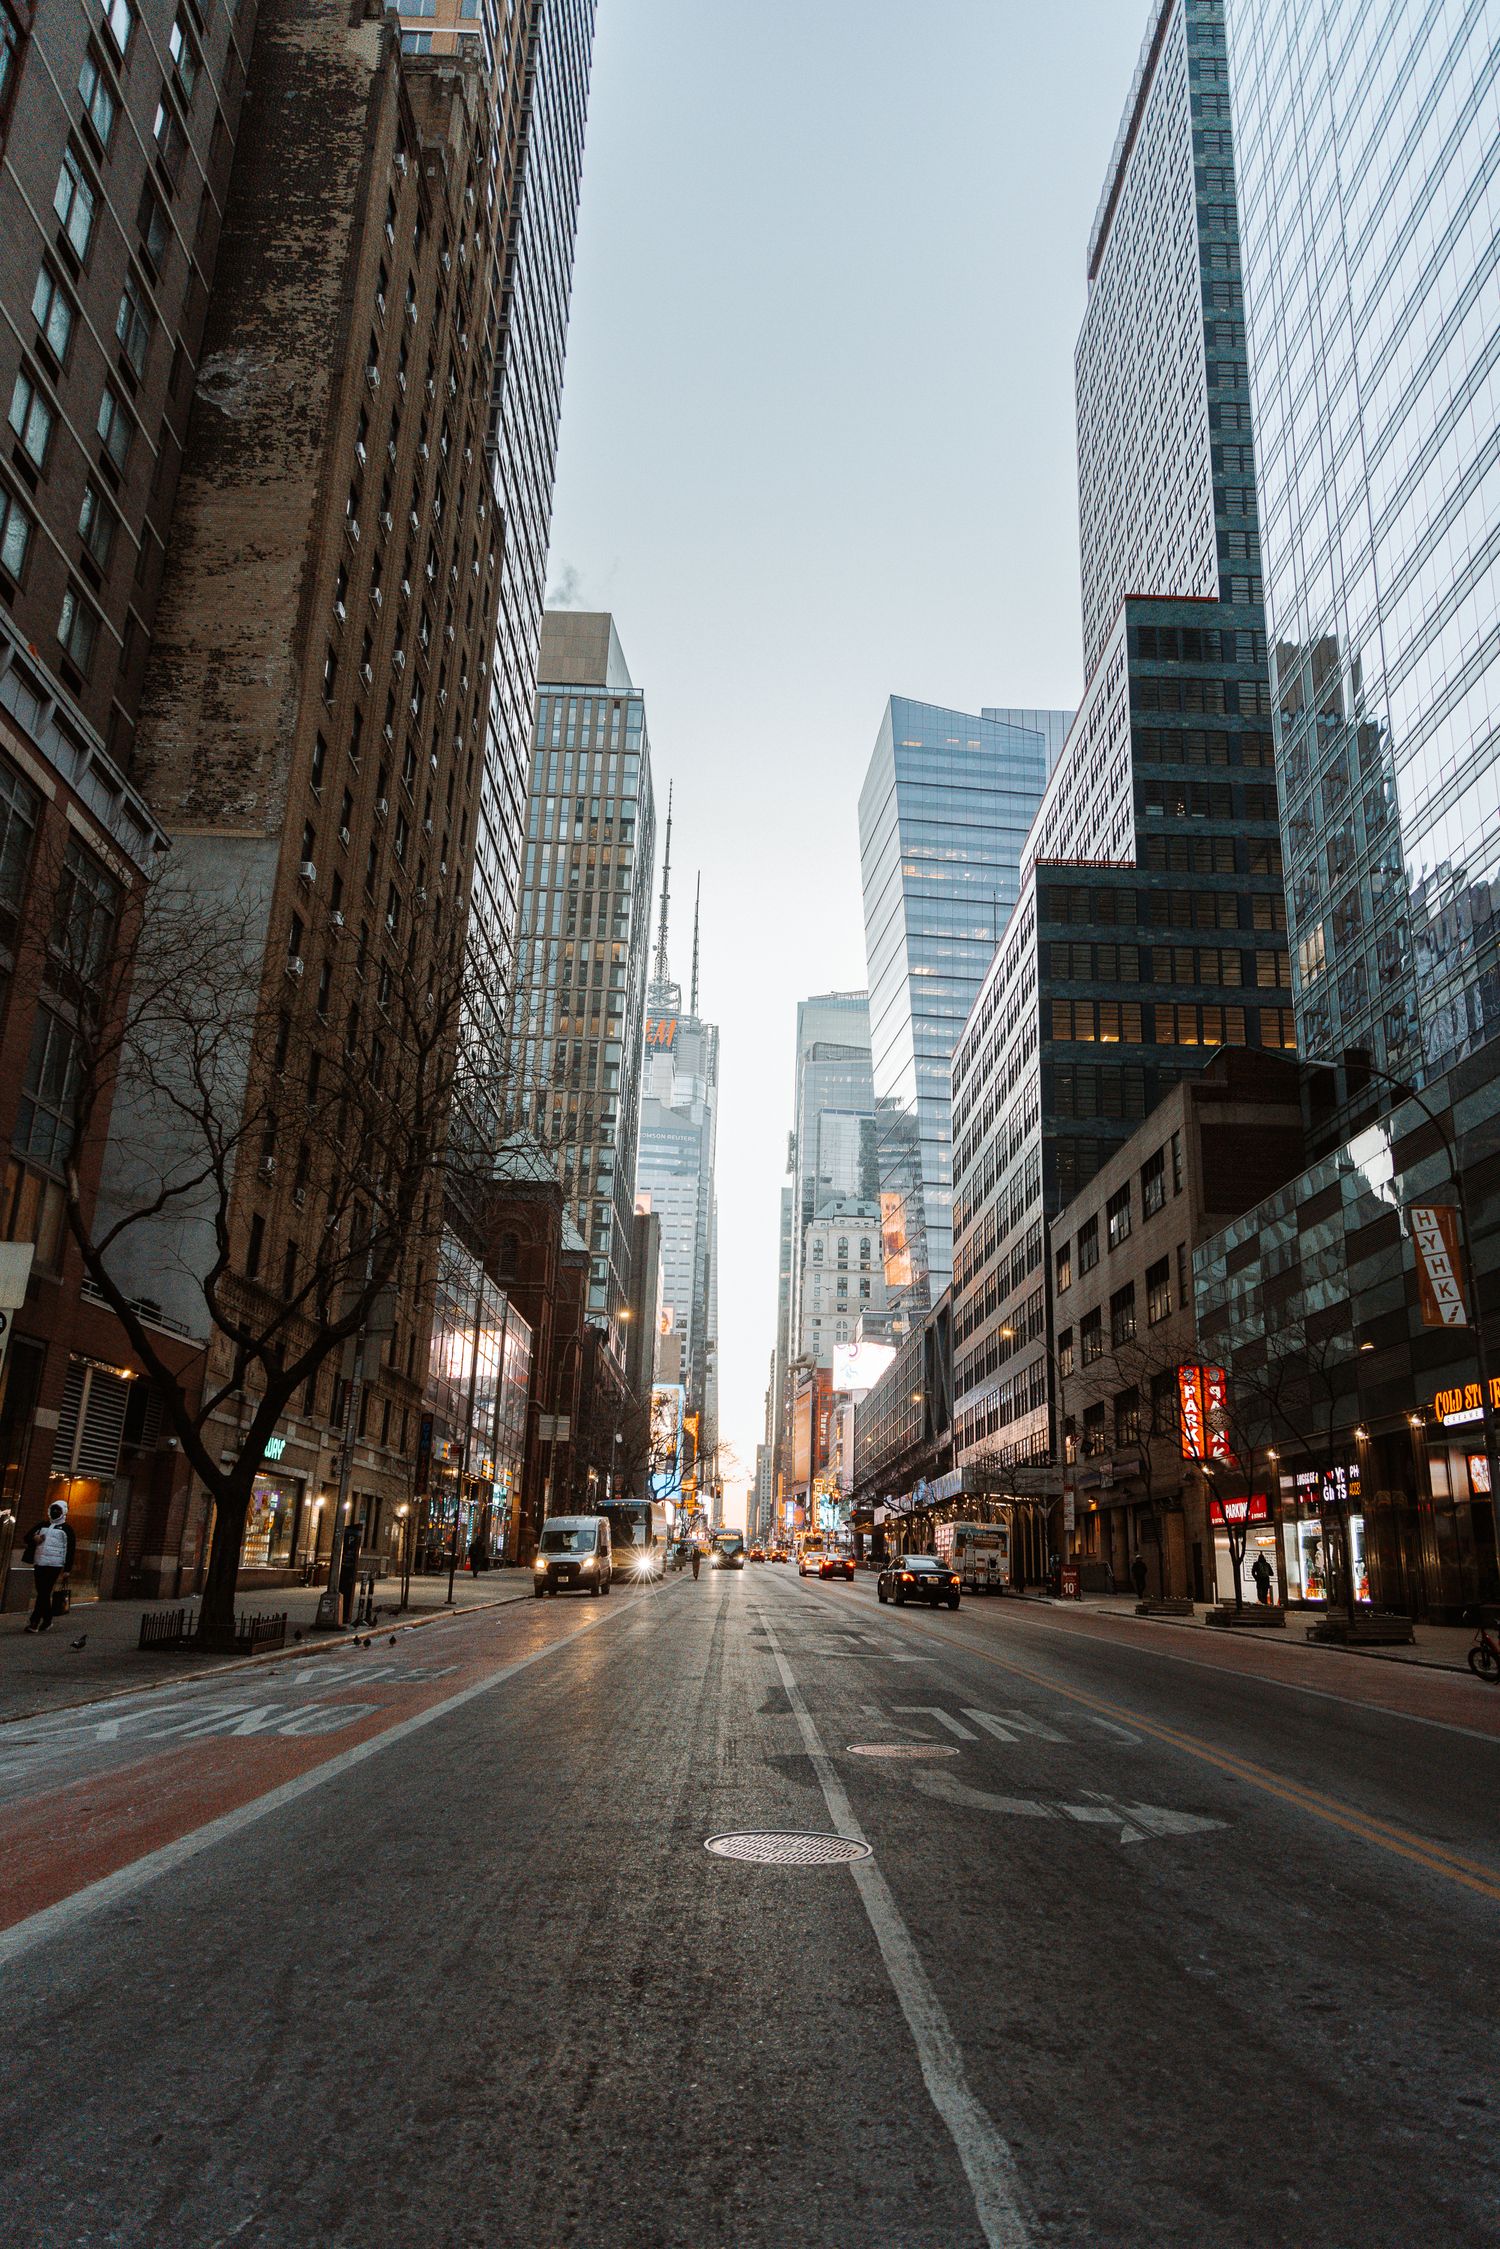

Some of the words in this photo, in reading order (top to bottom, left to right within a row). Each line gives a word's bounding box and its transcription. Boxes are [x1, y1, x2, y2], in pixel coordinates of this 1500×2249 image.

[667, 1134, 697, 1143] REUTERS
[1184, 1385, 1200, 1442] PARK
[1435, 1389, 1463, 1422] COLD
[1225, 1501, 1250, 1519] PARKIN
